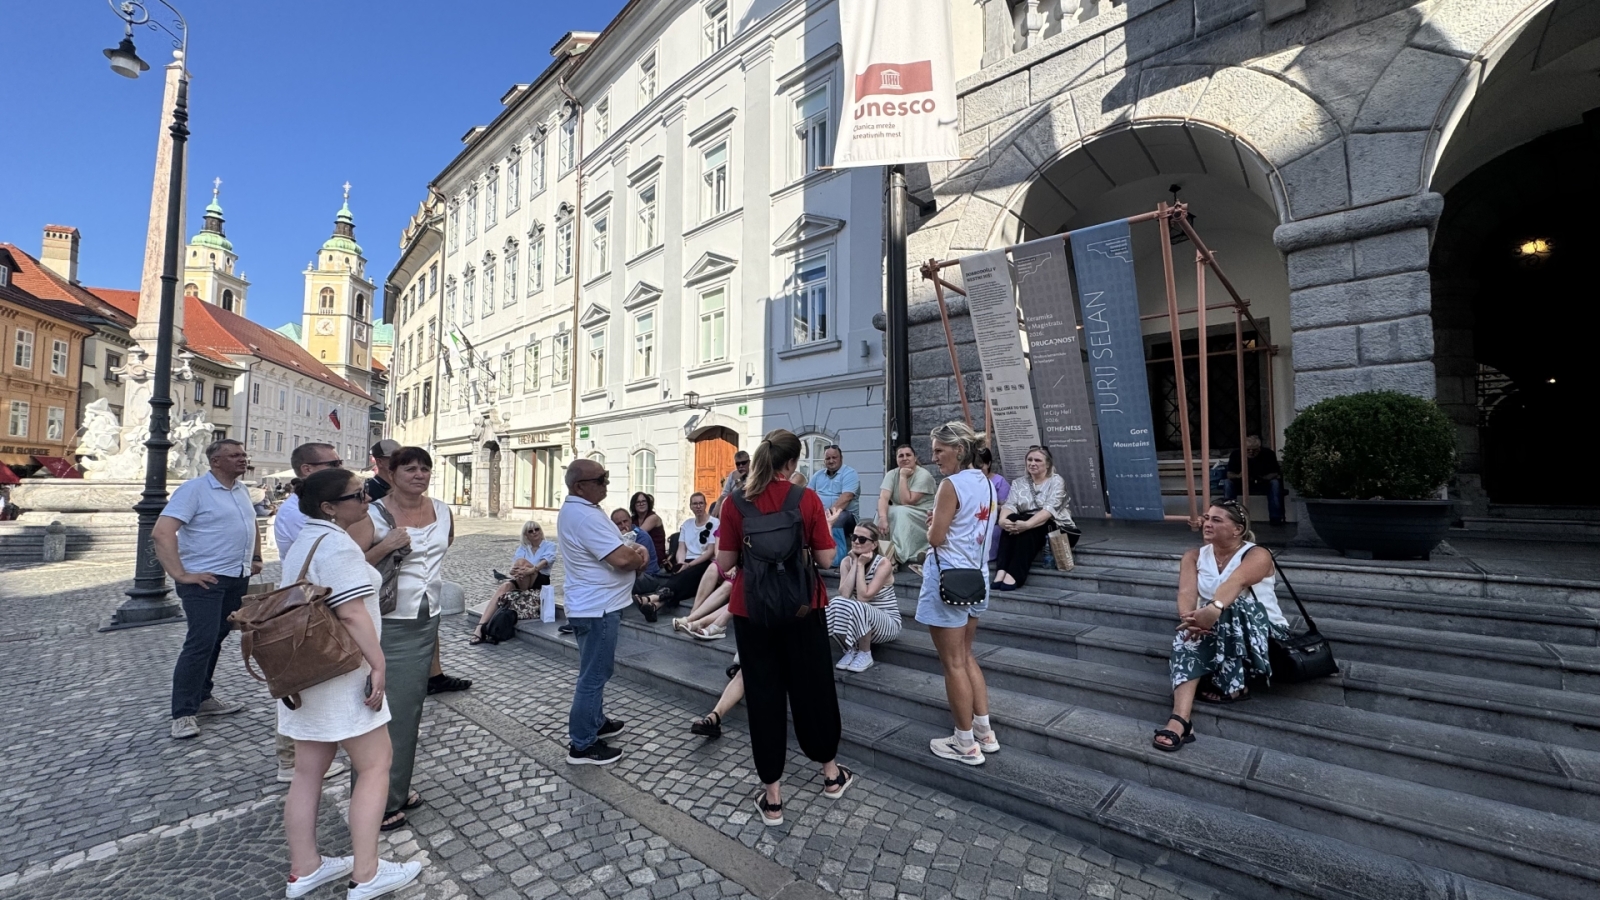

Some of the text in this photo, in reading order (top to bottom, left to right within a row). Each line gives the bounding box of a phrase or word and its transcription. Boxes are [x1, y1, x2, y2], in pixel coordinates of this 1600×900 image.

[854, 98, 936, 120] unesco
[1026, 313, 1054, 322] Keramika
[1083, 291, 1114, 360] SELAN
[1113, 440, 1150, 448] Mountains
